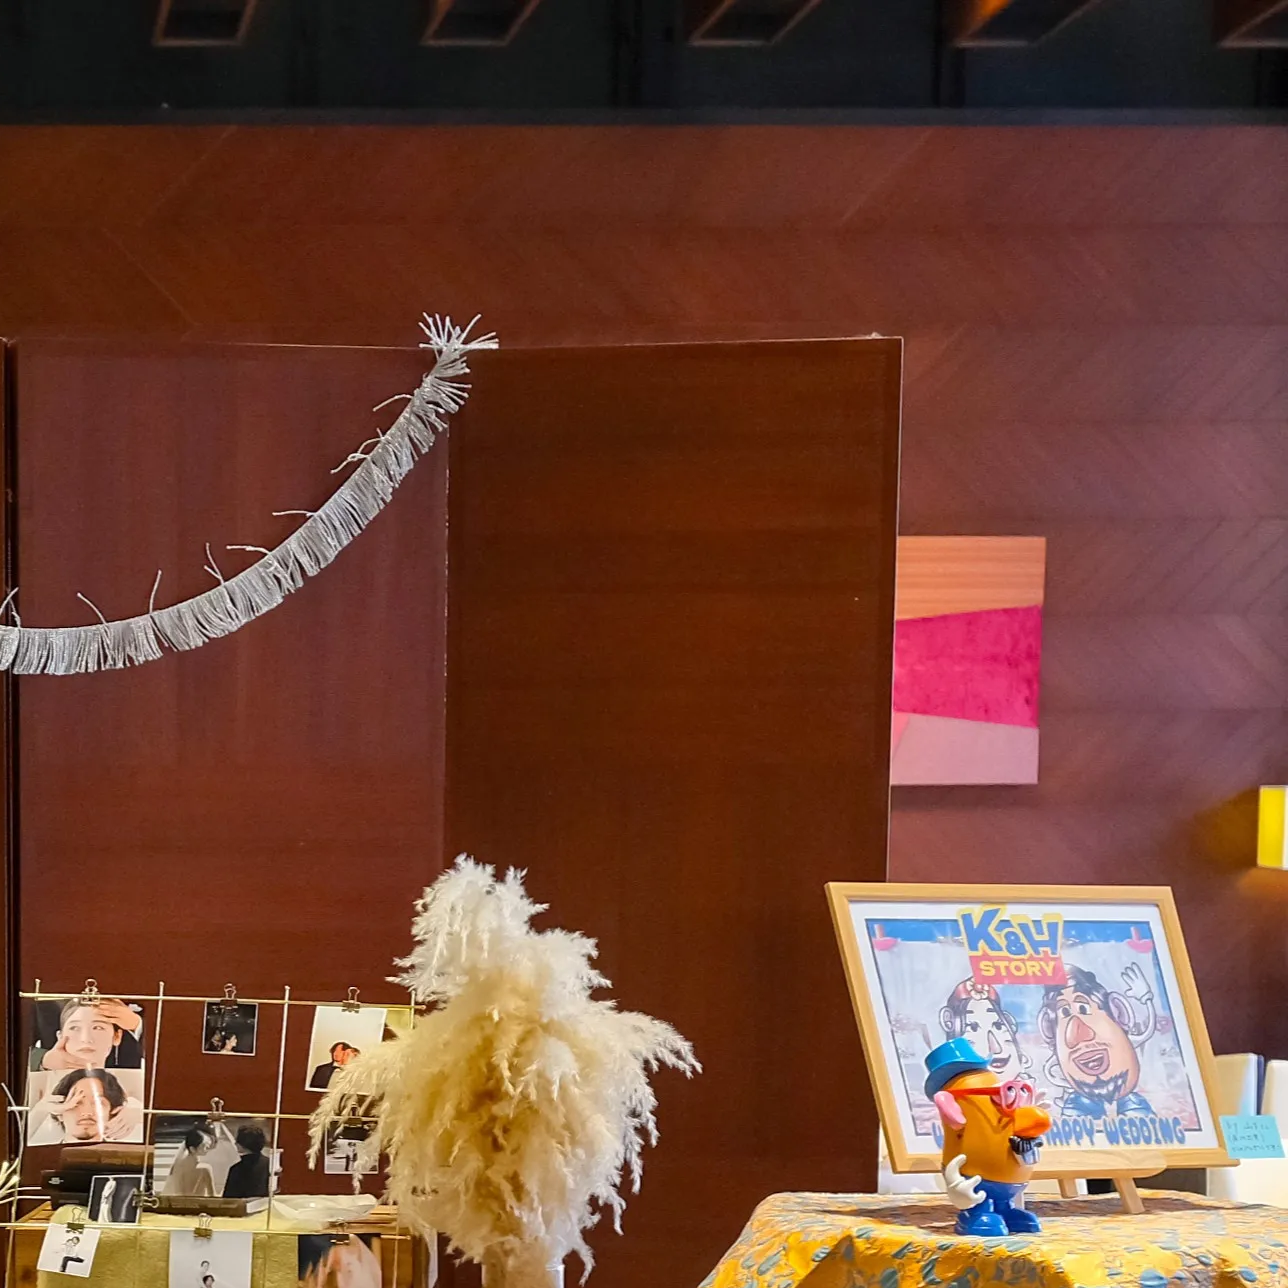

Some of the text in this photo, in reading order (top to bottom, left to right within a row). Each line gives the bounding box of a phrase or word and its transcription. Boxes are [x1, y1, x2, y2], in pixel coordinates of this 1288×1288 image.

[961, 908, 1060, 956] K&H
[979, 961, 1055, 976] STORY
[1103, 1117, 1186, 1145] WEDDING
